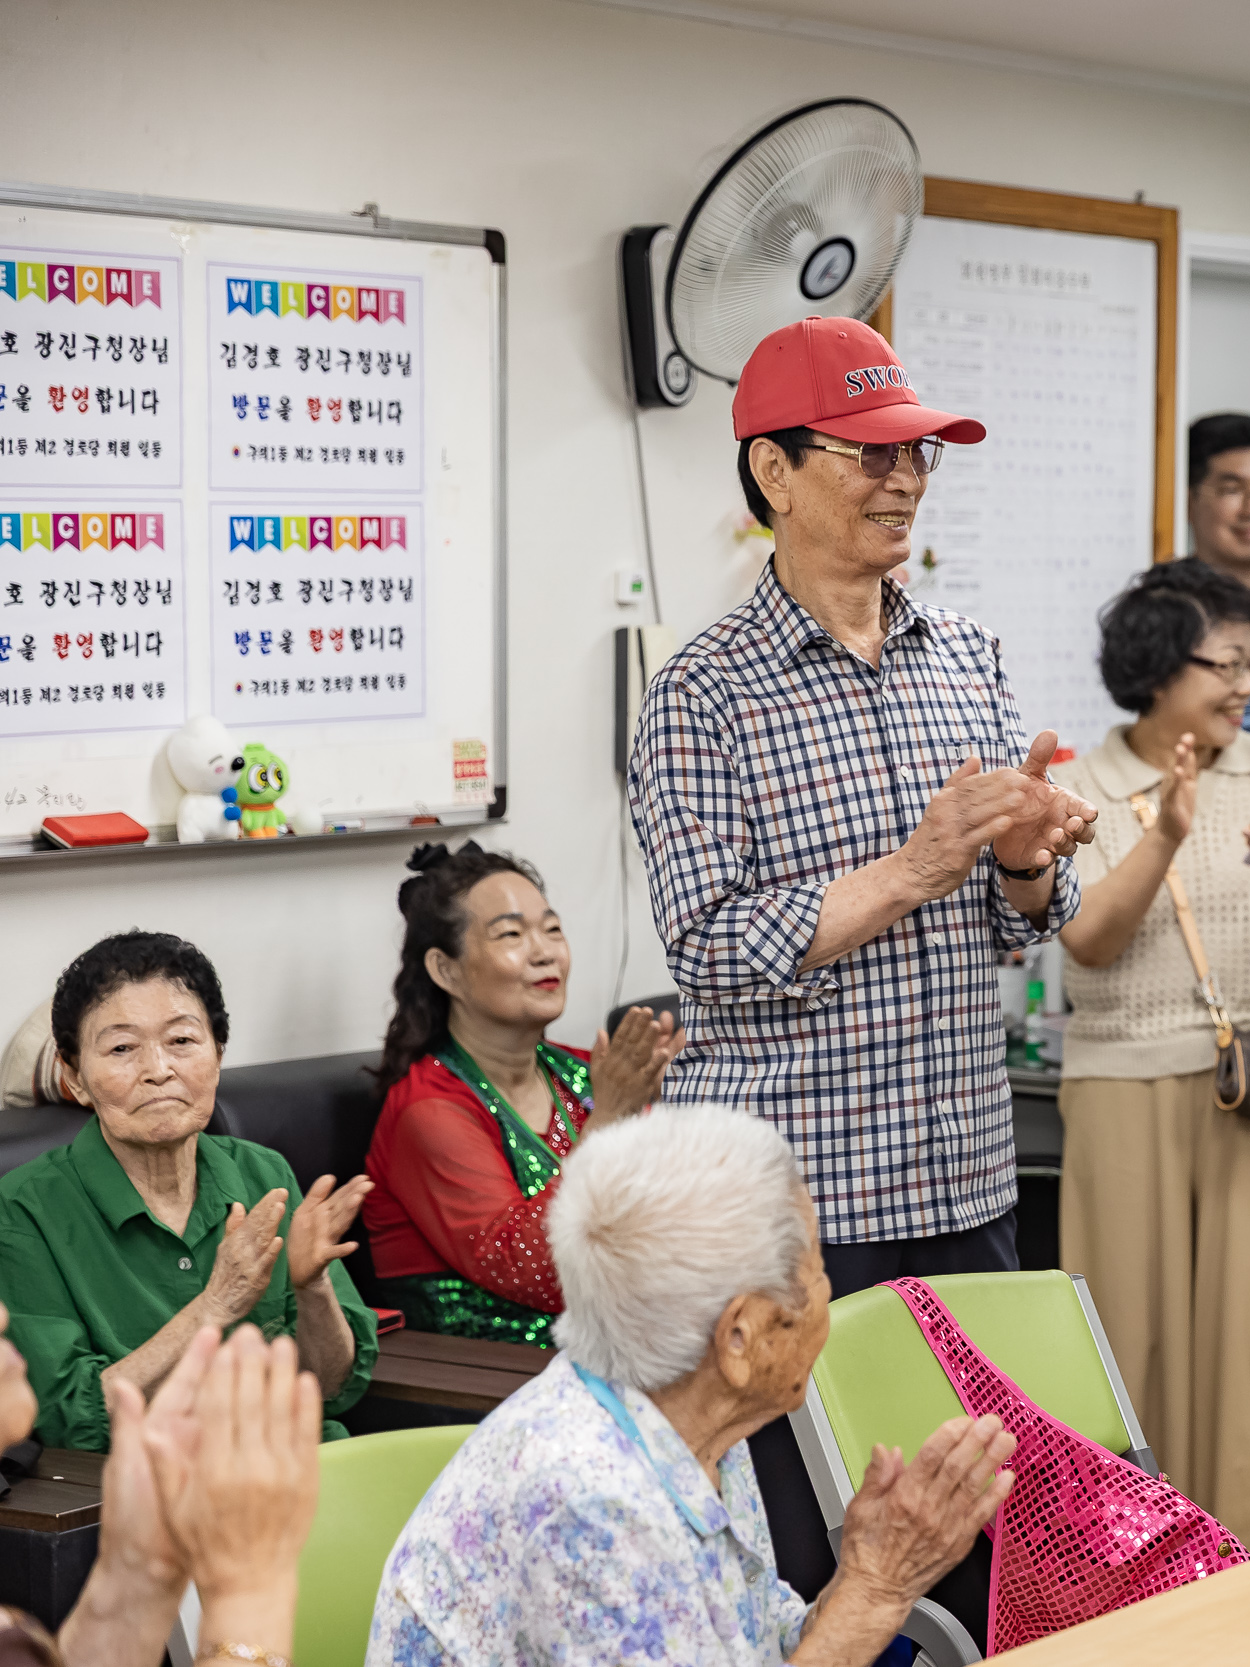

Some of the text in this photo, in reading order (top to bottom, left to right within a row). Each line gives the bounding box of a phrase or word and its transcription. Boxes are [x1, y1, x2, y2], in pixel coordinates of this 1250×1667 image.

[229, 280, 399, 314] WELCOME
[35, 331, 168, 364] 광진구청장님
[220, 342, 412, 377] 김경호 광진구청장님
[48, 386, 159, 415] 환영합니다
[232, 395, 402, 425] 방문을 환영합니다
[35, 438, 57, 456] 제2
[64, 438, 100, 457] 경로당
[107, 438, 130, 457] 회원
[138, 440, 162, 458] 일동
[247, 444, 405, 466] 구의1동 제2 경로당 회원 일동
[232, 518, 400, 541] WELCOME
[3, 579, 172, 608] 호 광진구청장님
[223, 577, 413, 606] 김경호 광진구청장님
[53, 631, 163, 660] 환영합니다
[234, 626, 404, 656] 방문을 환영합니다
[39, 686, 61, 704] 제2
[68, 684, 105, 704] 경로당
[112, 683, 135, 702] 회원
[142, 681, 166, 700] 일동
[250, 673, 406, 696] 구의1동 제2 경로당 회원 일동
